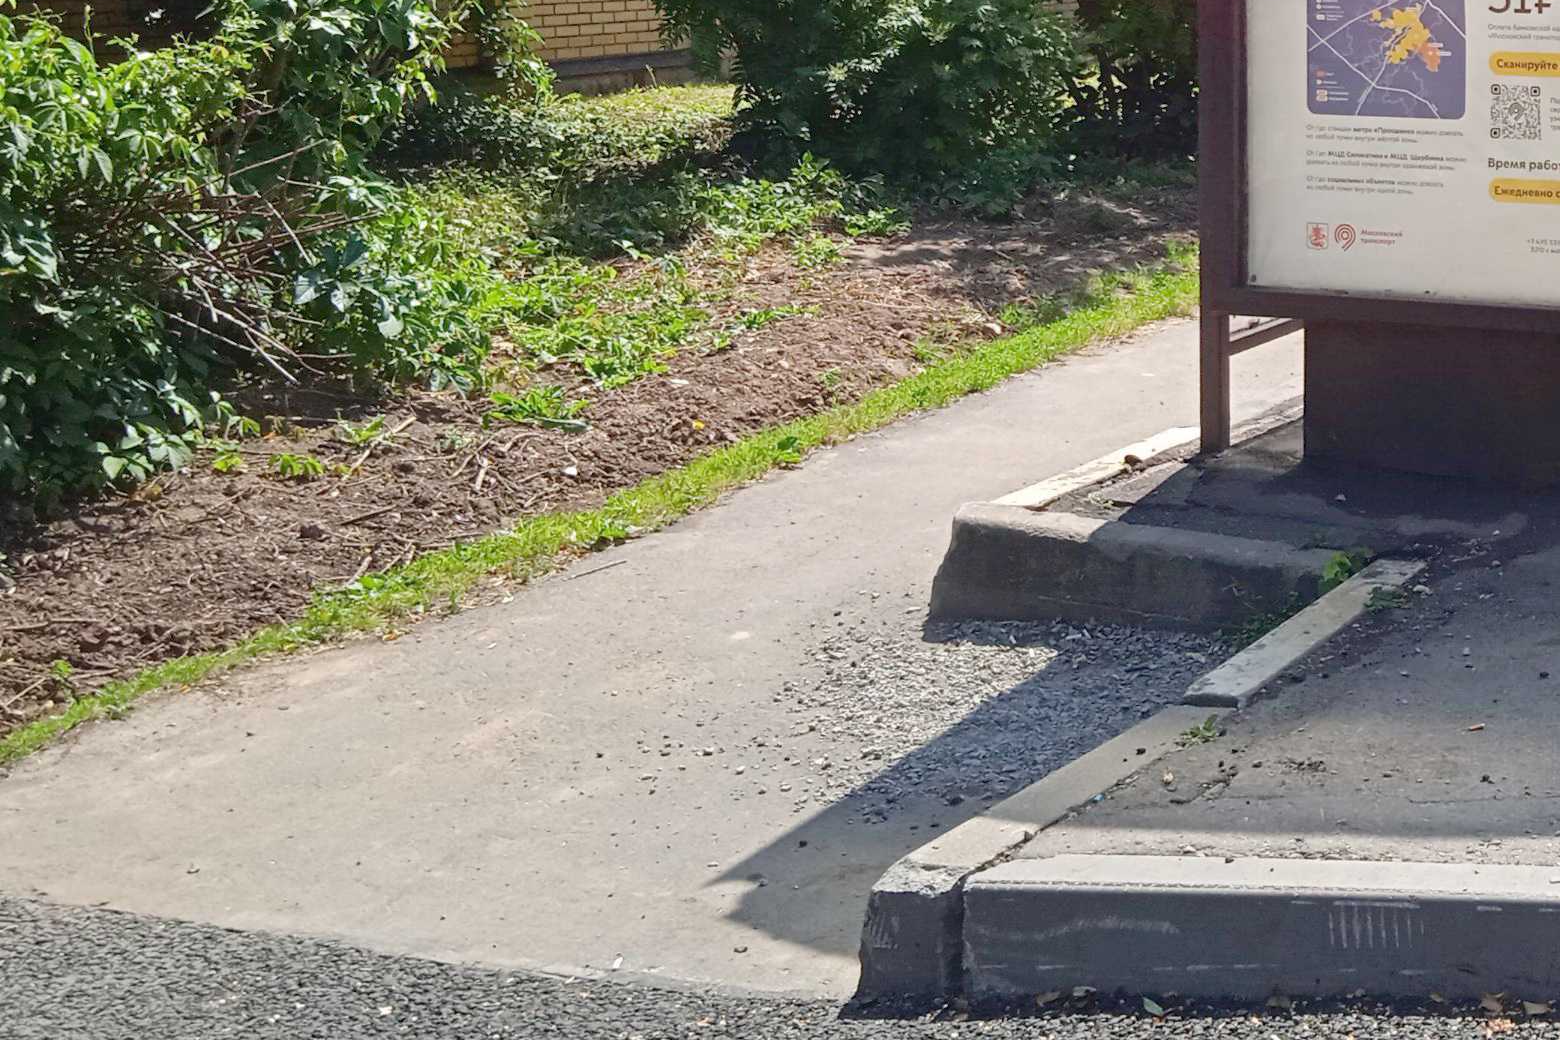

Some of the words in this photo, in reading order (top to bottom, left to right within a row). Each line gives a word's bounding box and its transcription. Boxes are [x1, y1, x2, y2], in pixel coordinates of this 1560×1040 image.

[1496, 58, 1558, 72] Сканируйте
[1488, 158, 1526, 171] Время
[1494, 185, 1552, 199] Ежедневно
[1555, 191, 1560, 199] с
